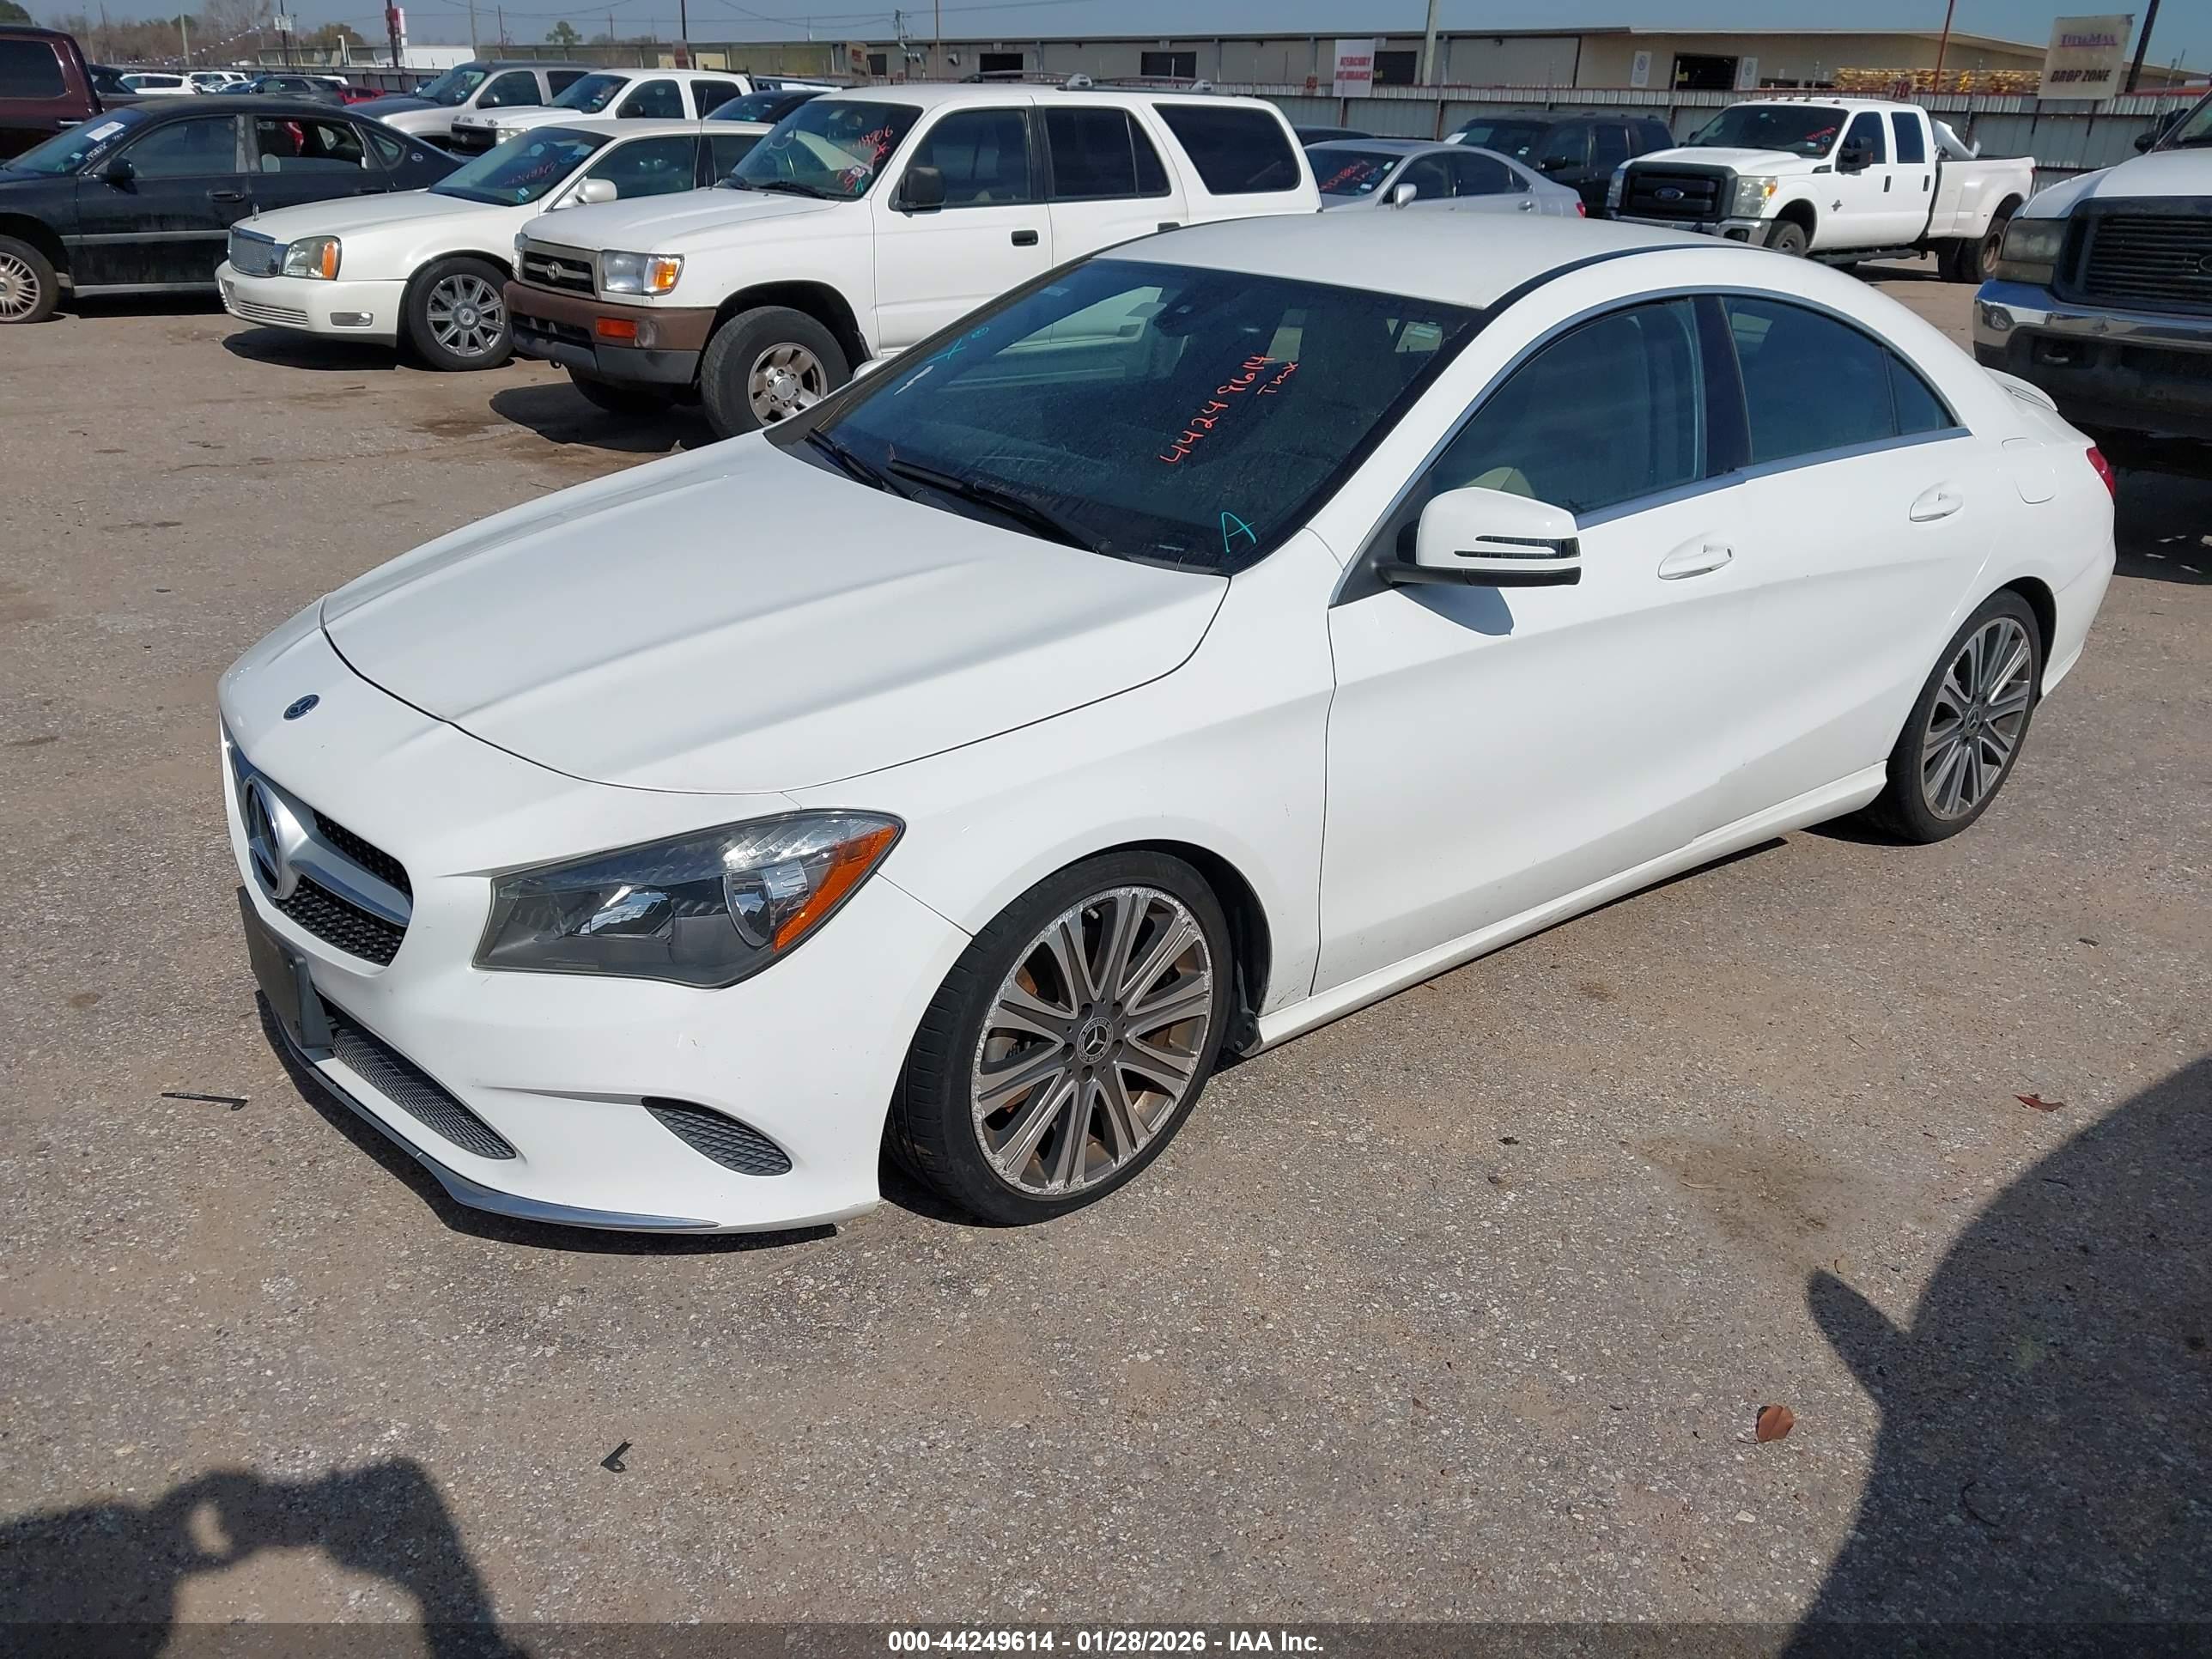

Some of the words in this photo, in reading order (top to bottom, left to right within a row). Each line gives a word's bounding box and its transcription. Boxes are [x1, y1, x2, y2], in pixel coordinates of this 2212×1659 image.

[2050, 70, 2081, 82] DROP
[2081, 69, 2112, 82] ZONE
[1220, 512, 1257, 554] A
